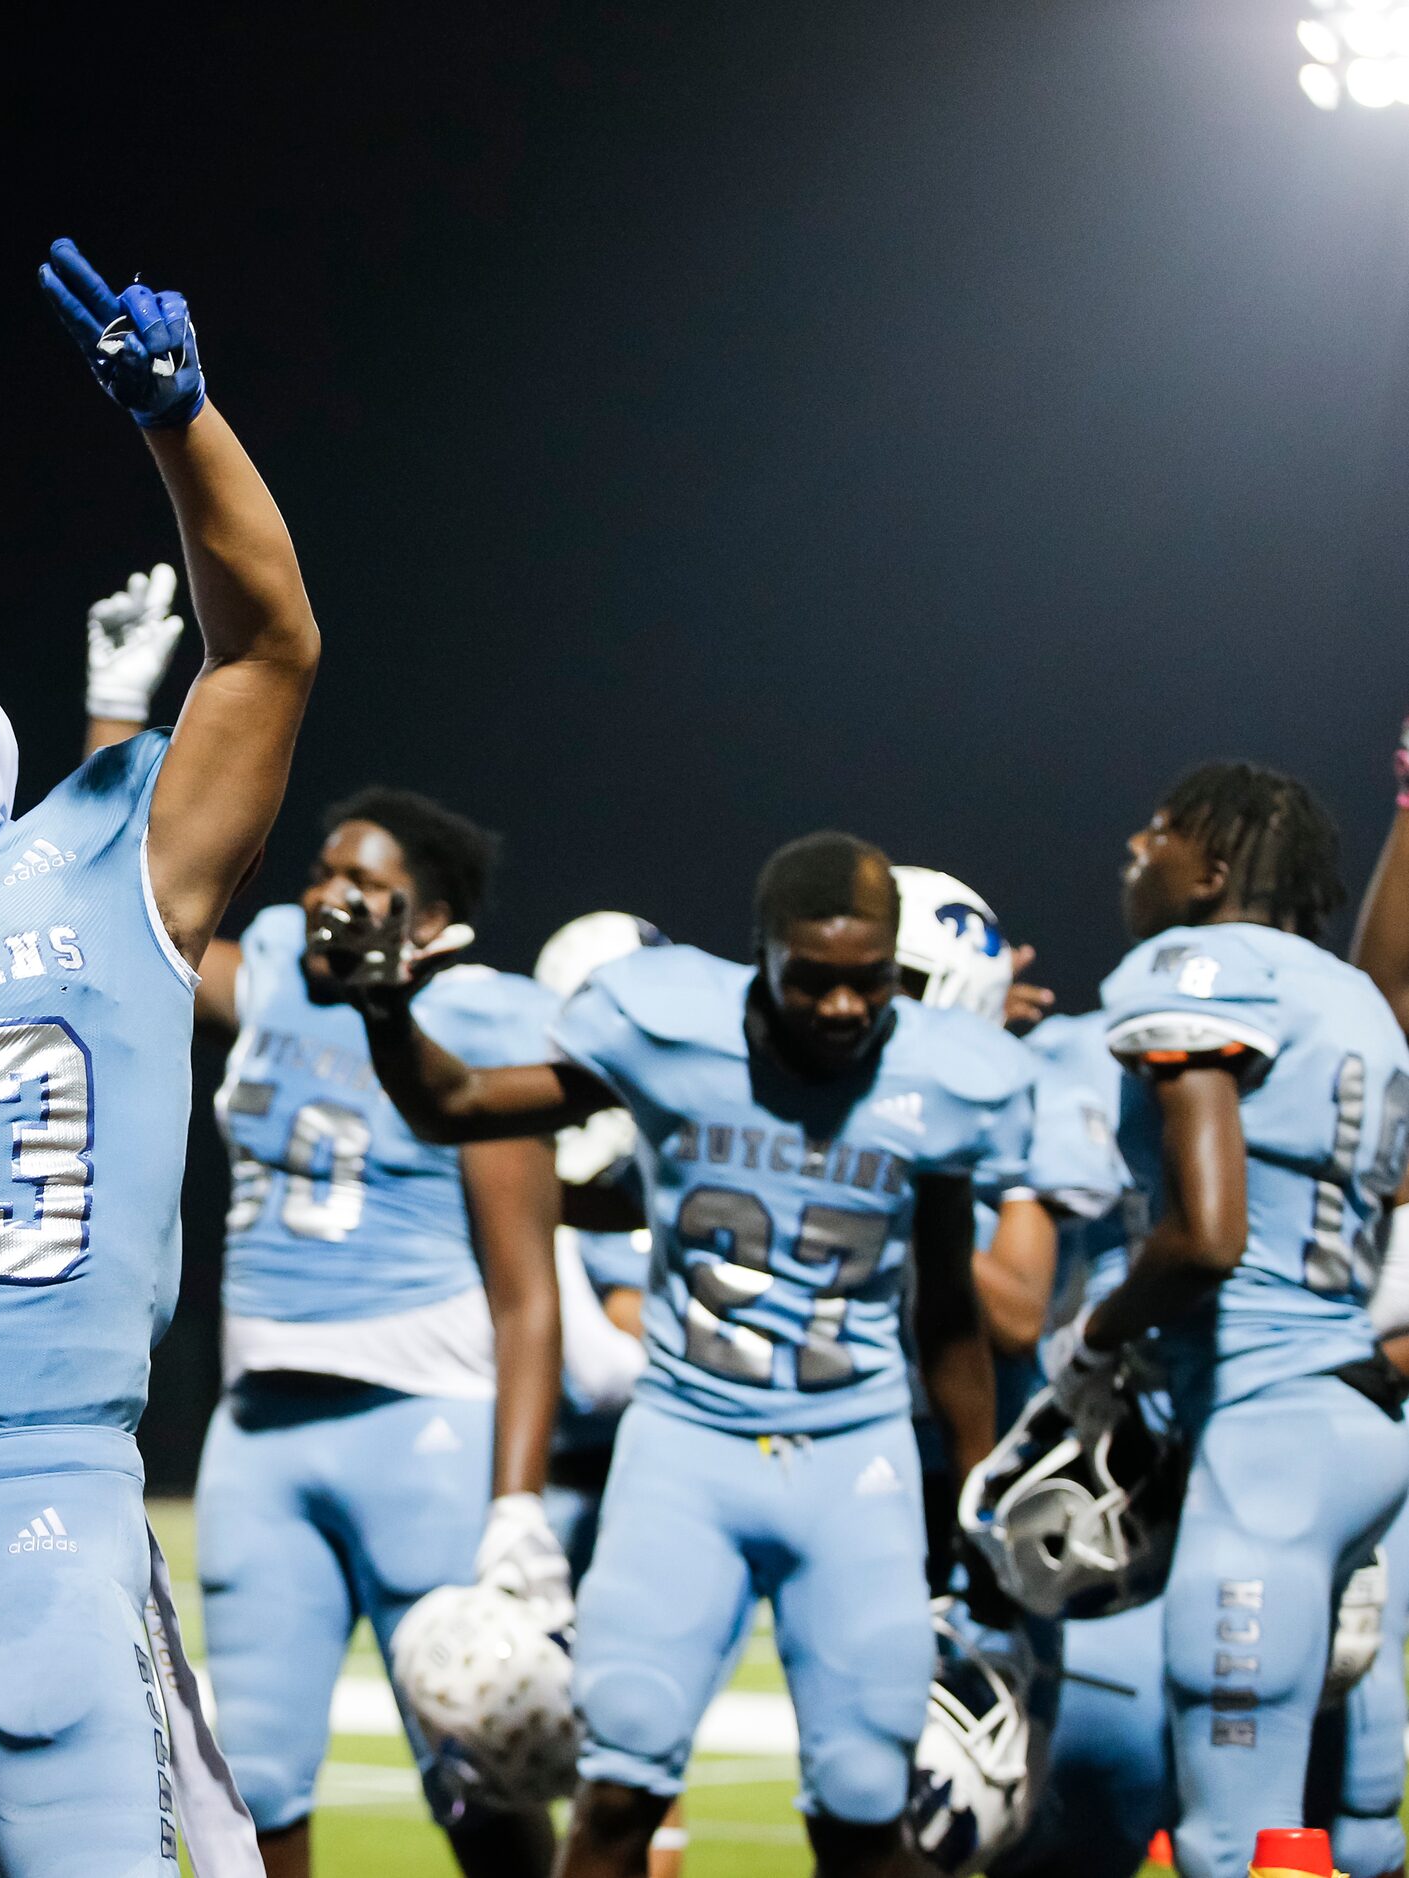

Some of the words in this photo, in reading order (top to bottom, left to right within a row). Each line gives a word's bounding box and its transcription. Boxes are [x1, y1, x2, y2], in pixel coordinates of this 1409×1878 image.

[3, 849, 77, 886] adidas
[678, 1184, 890, 1393] 27
[8, 1534, 79, 1554] adidas
